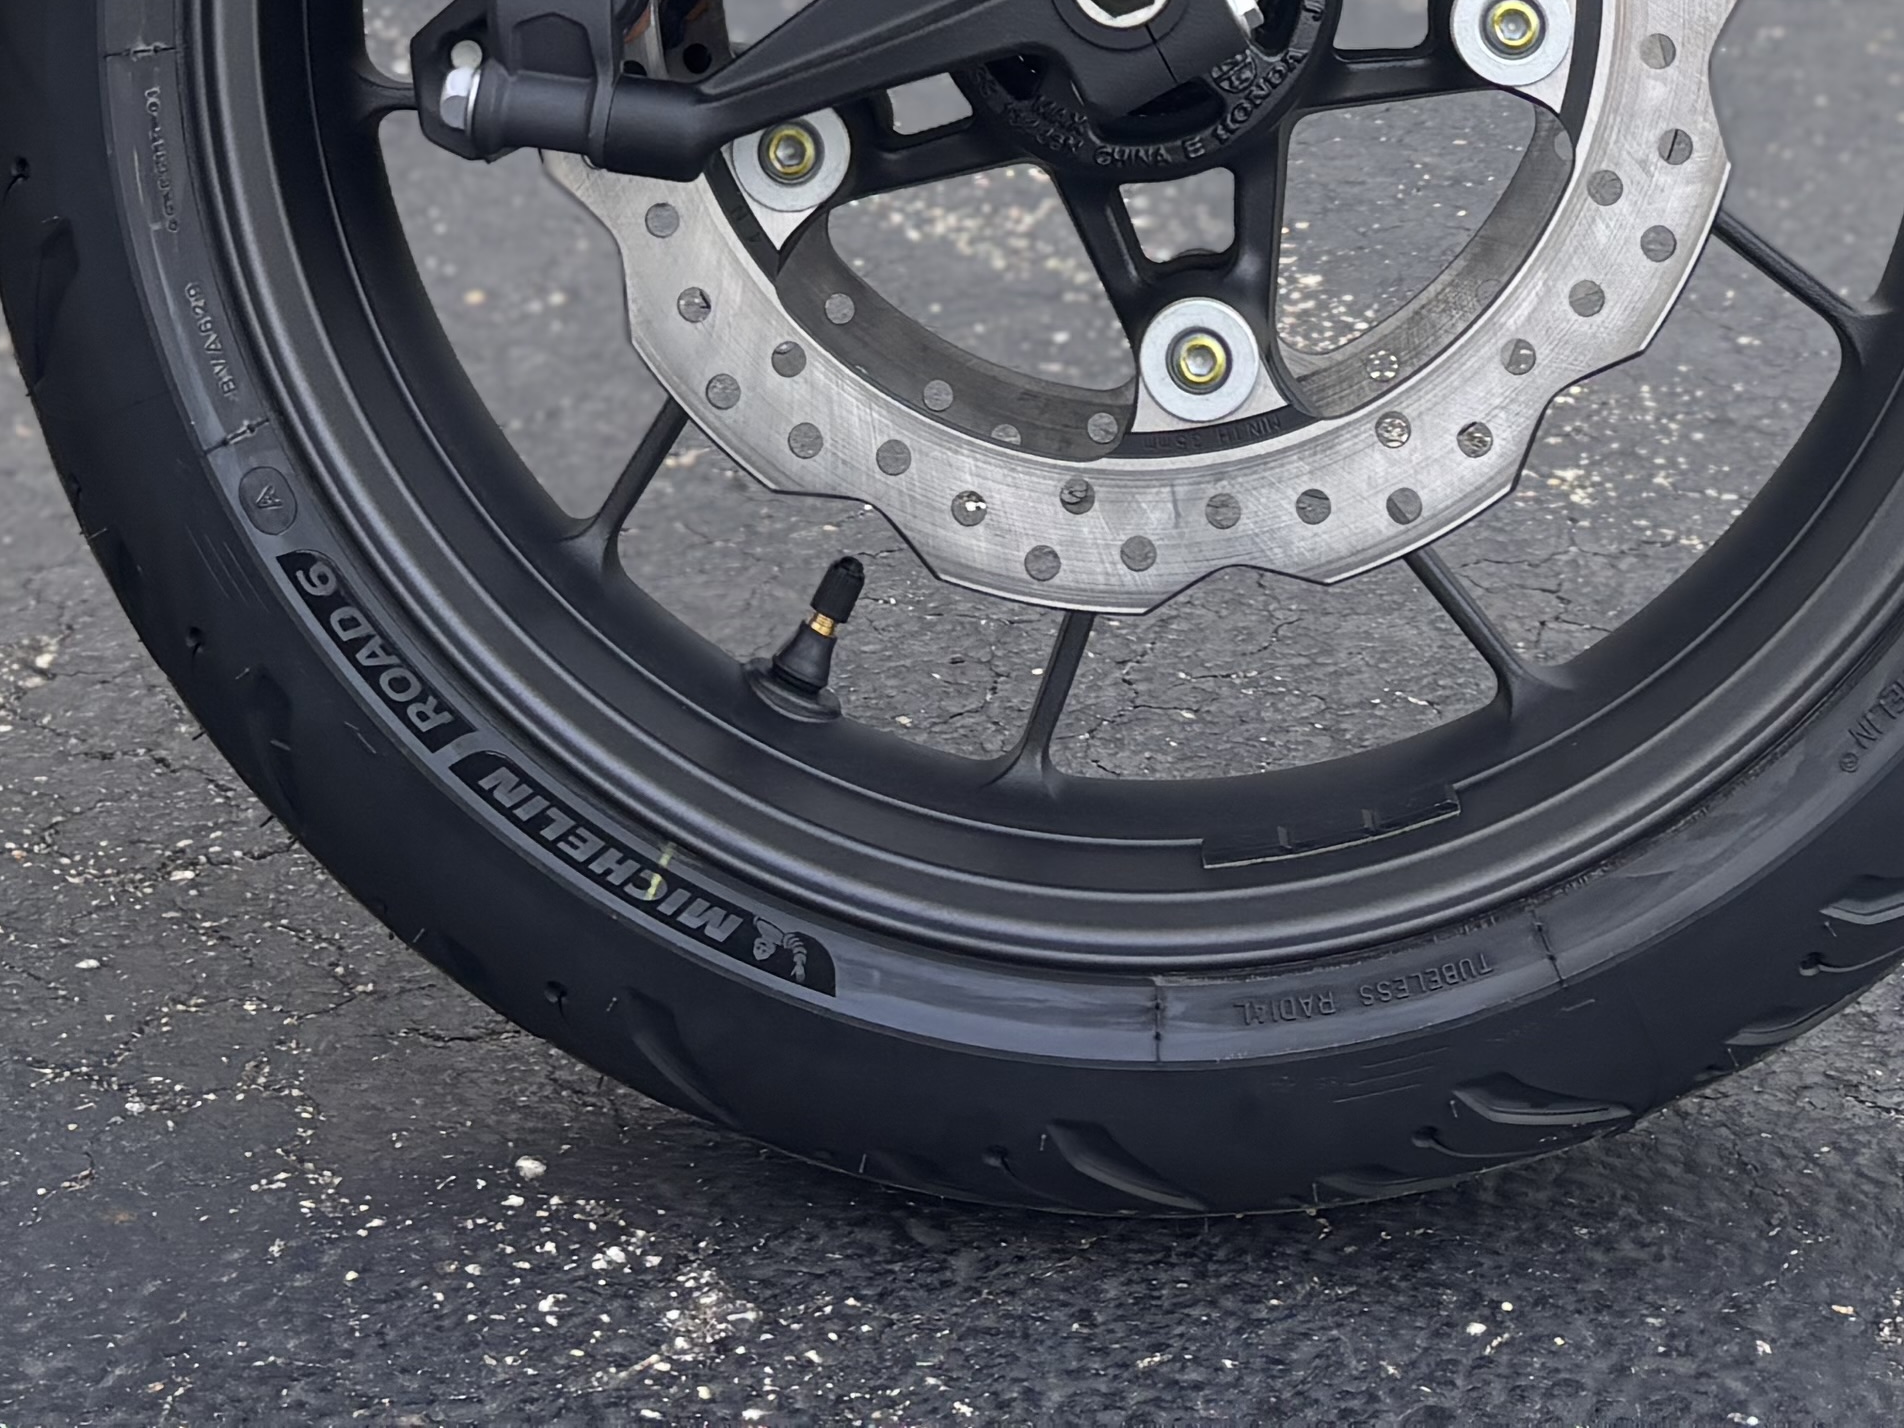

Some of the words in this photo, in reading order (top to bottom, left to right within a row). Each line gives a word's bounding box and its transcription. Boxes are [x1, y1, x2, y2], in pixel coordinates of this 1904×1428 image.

[1211, 47, 1311, 144] HONDA
[295, 558, 339, 599] 6
[332, 604, 457, 738] ROAD
[479, 767, 743, 944] MICHELIN
[1231, 988, 1338, 1028] RADIAL
[1360, 951, 1495, 1010] TUBELESS
